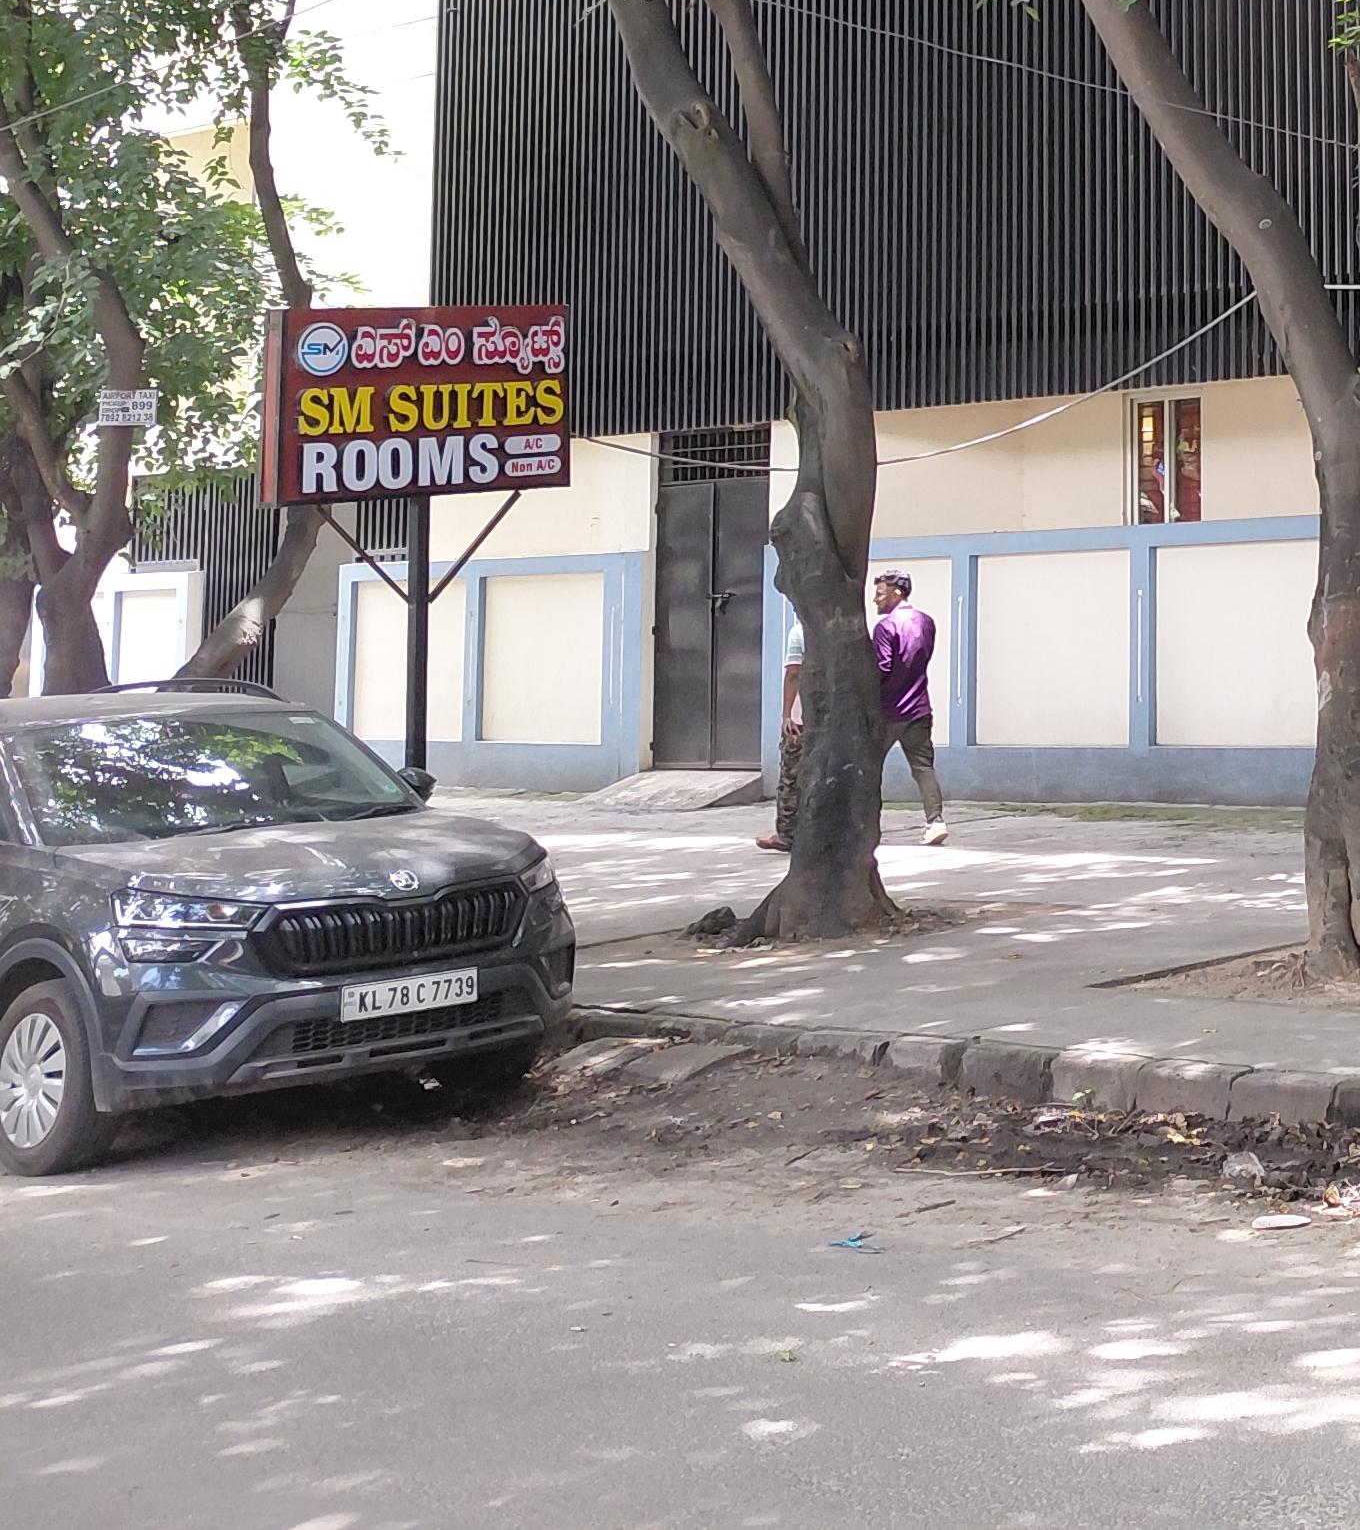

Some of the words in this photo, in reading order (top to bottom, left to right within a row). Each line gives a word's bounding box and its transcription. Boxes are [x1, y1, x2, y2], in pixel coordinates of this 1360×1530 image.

[351, 319, 416, 369] ಎಸ್
[418, 323, 465, 366] ಎಂ
[131, 401, 153, 411] 899
[299, 387, 375, 436] SM
[388, 380, 564, 433] SUITES
[524, 437, 543, 450] A/C
[301, 434, 499, 494] ROOMS
[511, 461, 533, 474] Non
[536, 458, 556, 471] A/C
[358, 989, 382, 1014] KL
[388, 985, 410, 1009] 78
[416, 982, 426, 1004] C
[431, 975, 474, 1002] 7739
